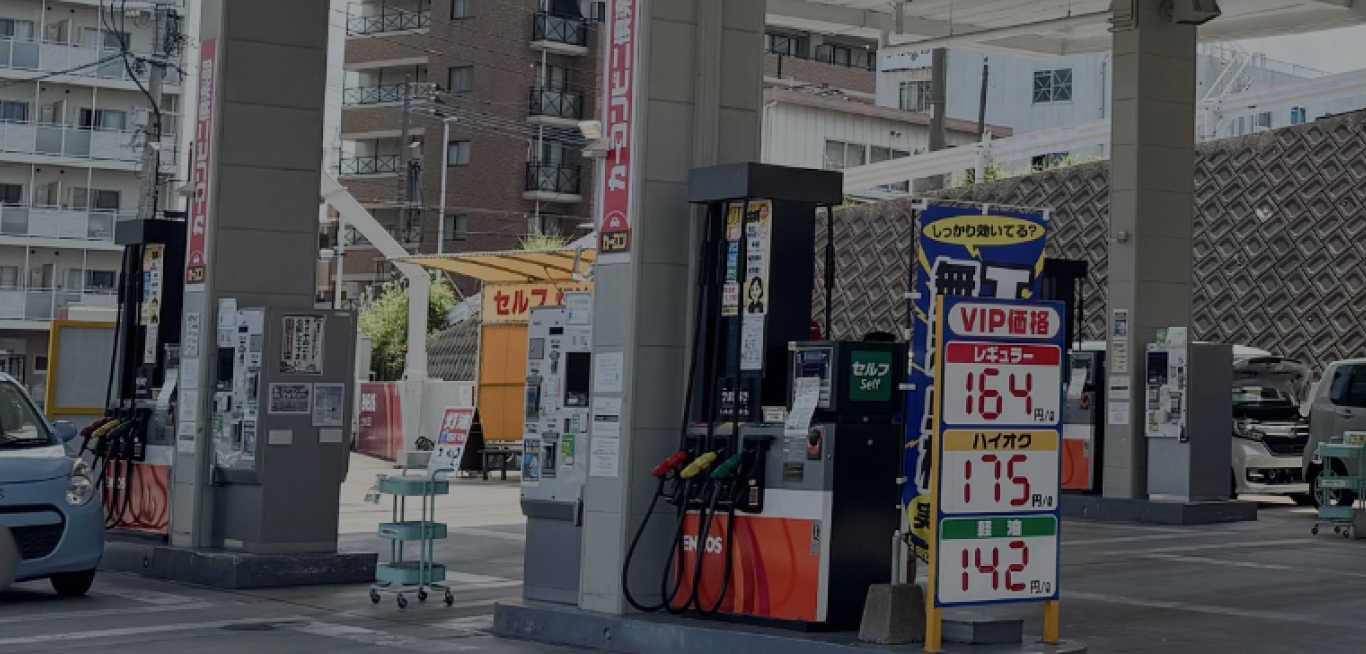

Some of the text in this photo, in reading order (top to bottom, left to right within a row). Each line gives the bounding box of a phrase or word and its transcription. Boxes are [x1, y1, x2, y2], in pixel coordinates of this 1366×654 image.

[960, 307, 1050, 335] VIP価格
[974, 347, 1035, 363] レギュラー
[852, 361, 890, 377] セルフ
[859, 378, 881, 391] Self
[966, 368, 1032, 420] 164
[973, 433, 1032, 449] ハイオク
[964, 454, 1031, 506] 175
[683, 534, 723, 554] ENOS
[962, 540, 1029, 592] 142
